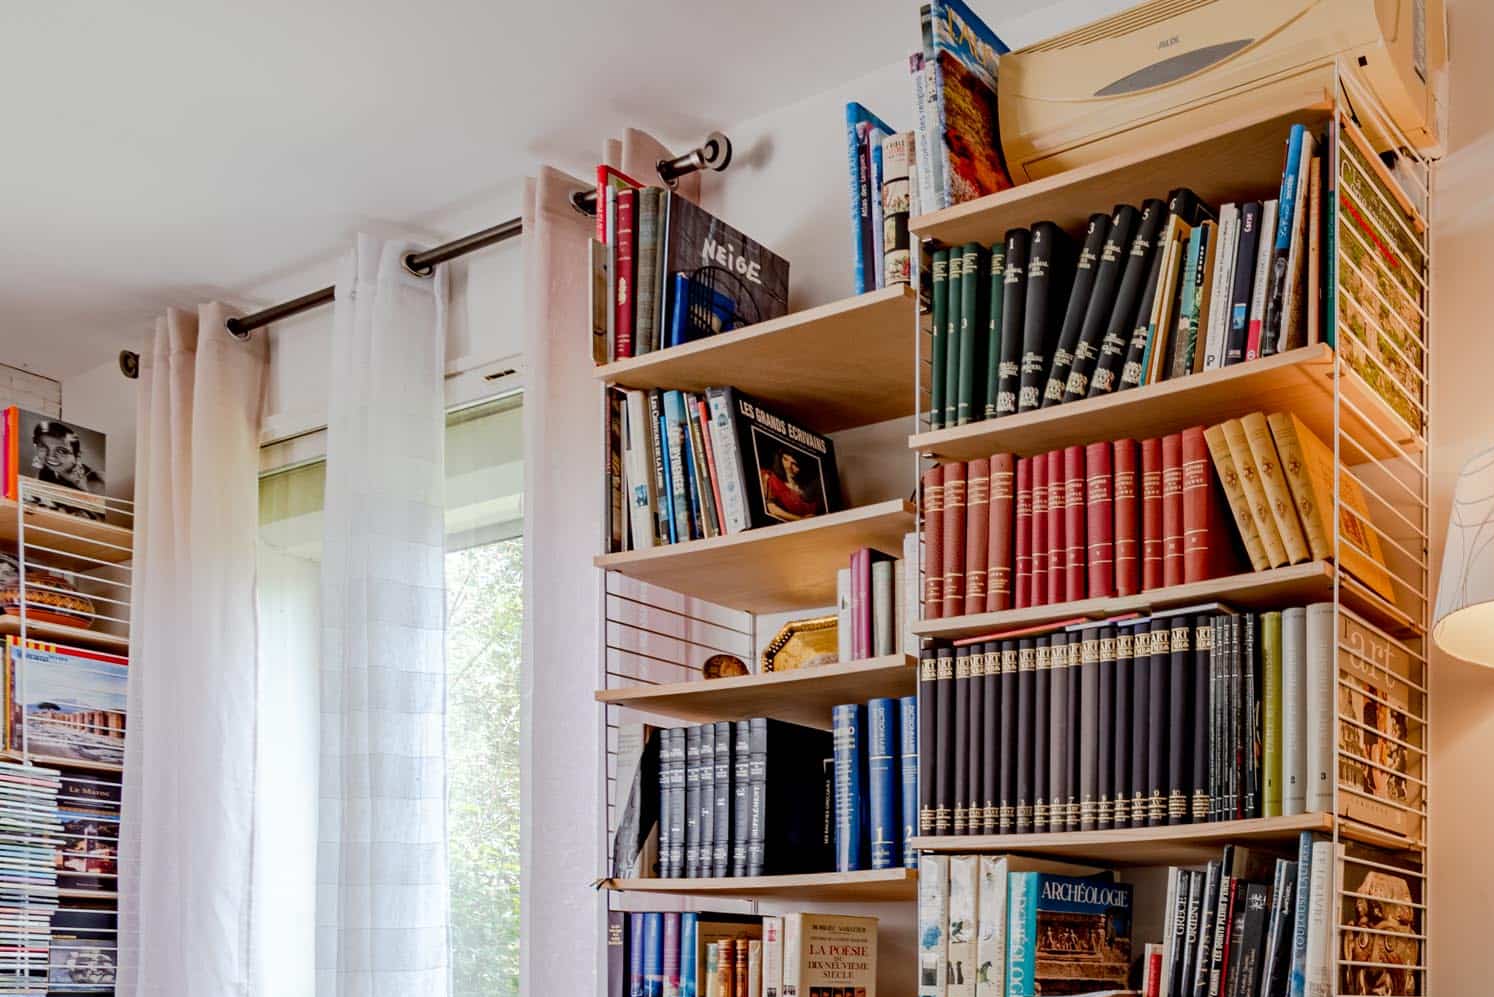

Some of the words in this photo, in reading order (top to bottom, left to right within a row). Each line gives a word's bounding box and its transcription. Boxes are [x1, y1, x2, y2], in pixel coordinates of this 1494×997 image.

[1141, 207, 1150, 221] 5
[1034, 231, 1042, 244] 2
[739, 399, 755, 420] LES
[755, 408, 787, 436] GRANDS
[1040, 880, 1129, 908] ARCHÉOLOGIE
[1188, 897, 1200, 943] ORIENT
